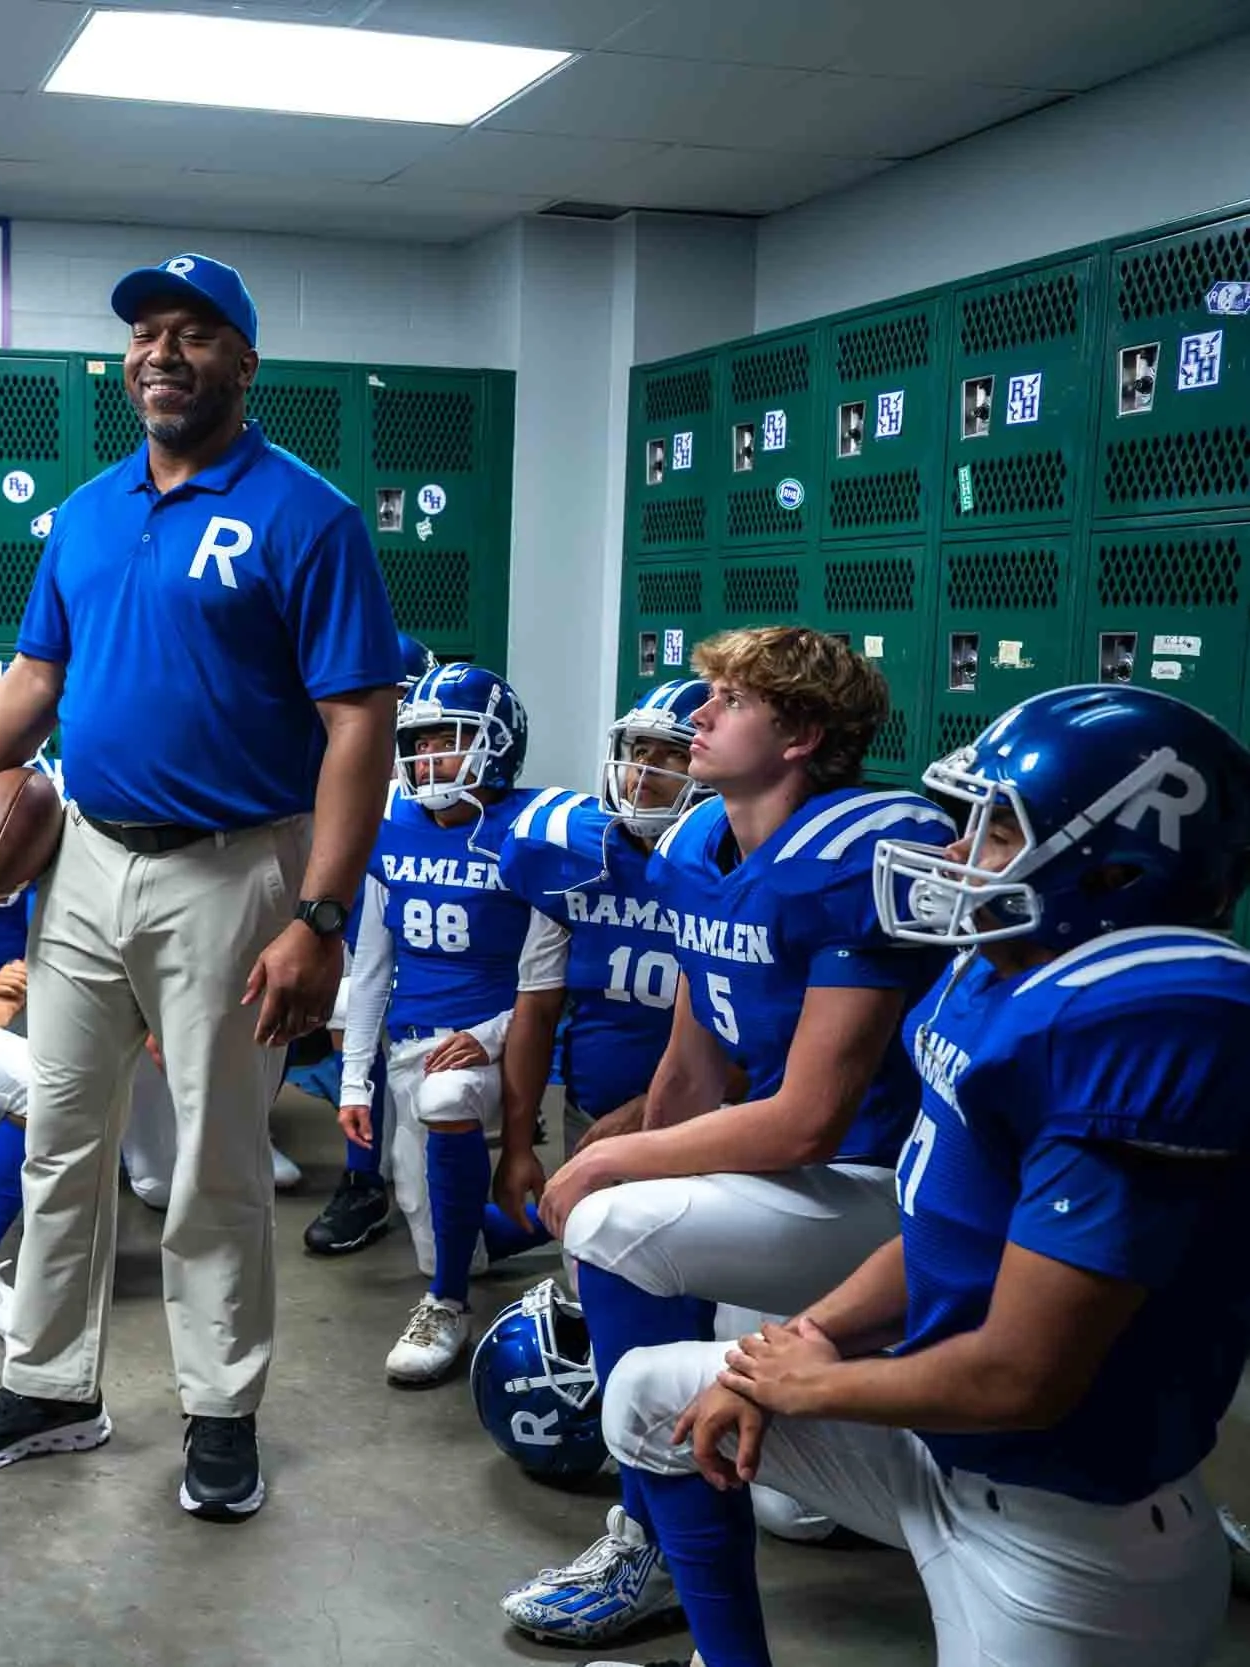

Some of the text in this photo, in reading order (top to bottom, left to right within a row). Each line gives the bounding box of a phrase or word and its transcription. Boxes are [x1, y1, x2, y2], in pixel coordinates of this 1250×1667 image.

[188, 515, 253, 589] R
[1115, 768, 1207, 851] R
[403, 898, 470, 952] 88
[604, 946, 679, 1010] 10
[706, 971, 739, 1045] 5
[511, 1409, 562, 1446] R
